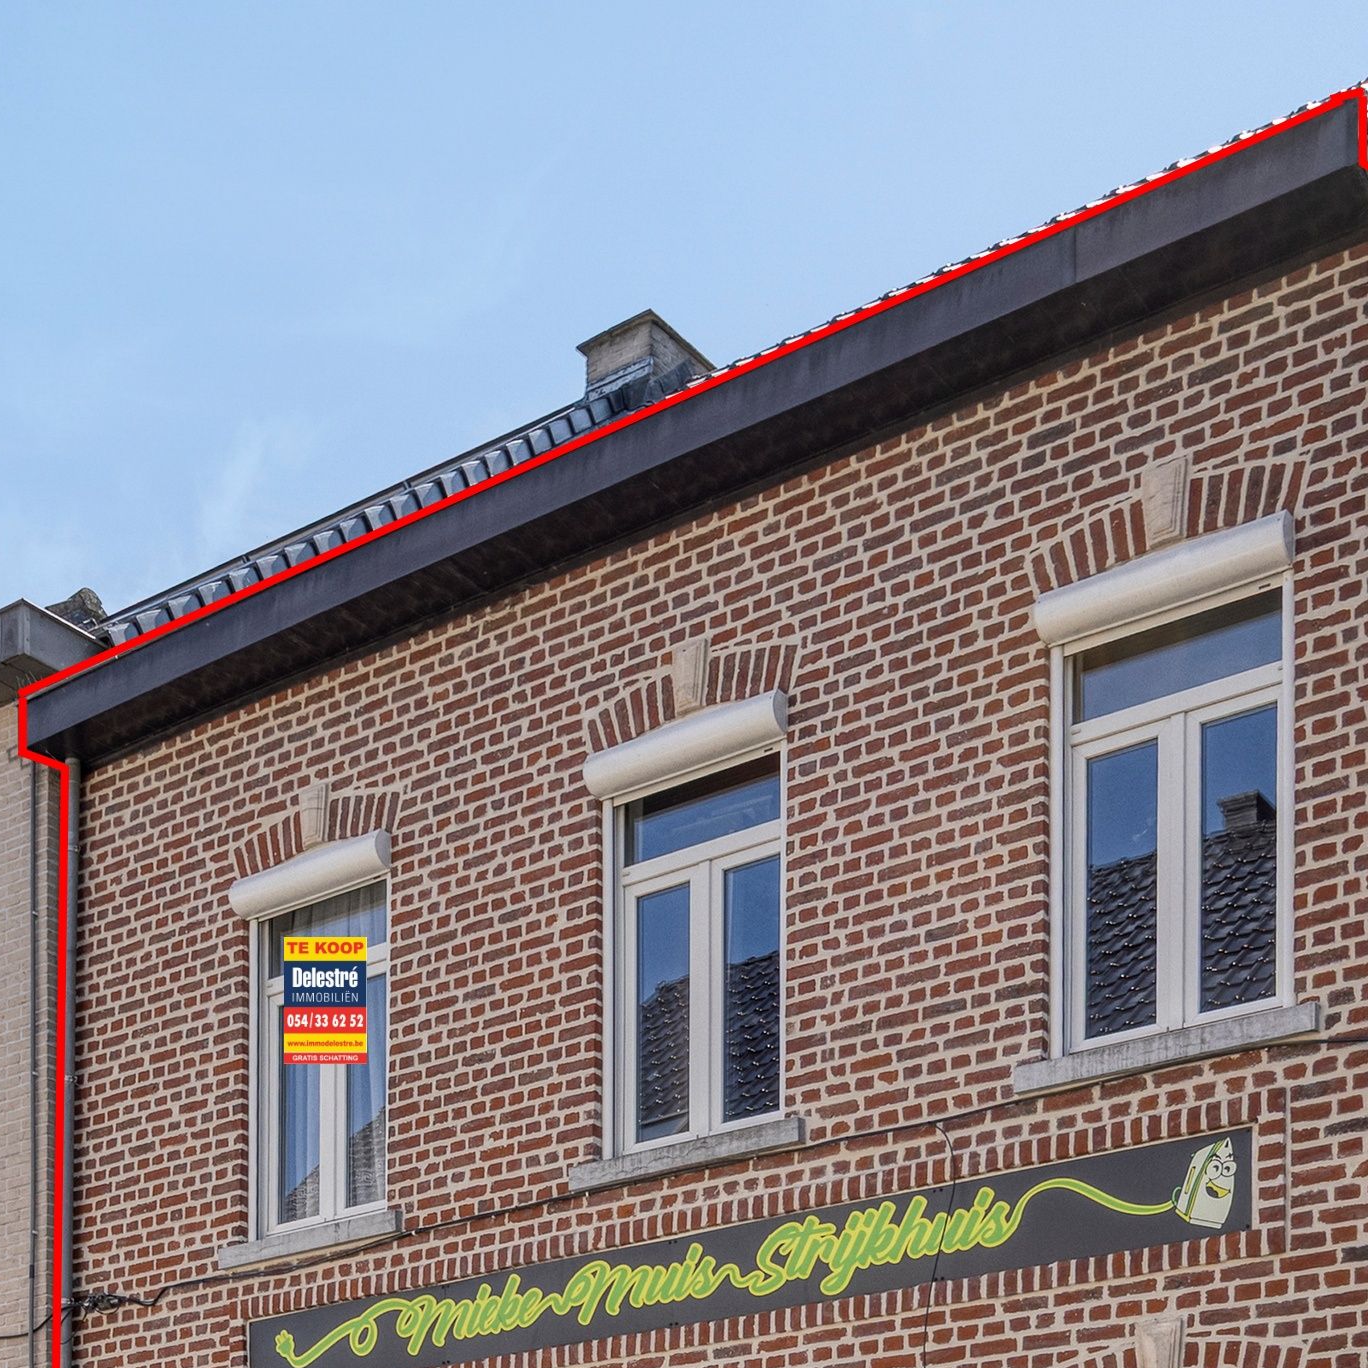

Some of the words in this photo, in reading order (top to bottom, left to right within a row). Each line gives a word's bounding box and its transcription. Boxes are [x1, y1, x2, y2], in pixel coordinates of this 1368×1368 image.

[396, 1274, 546, 1356] Mieke
[563, 1242, 720, 1326] Muis
[742, 1186, 1016, 1297] Strijkhuis
